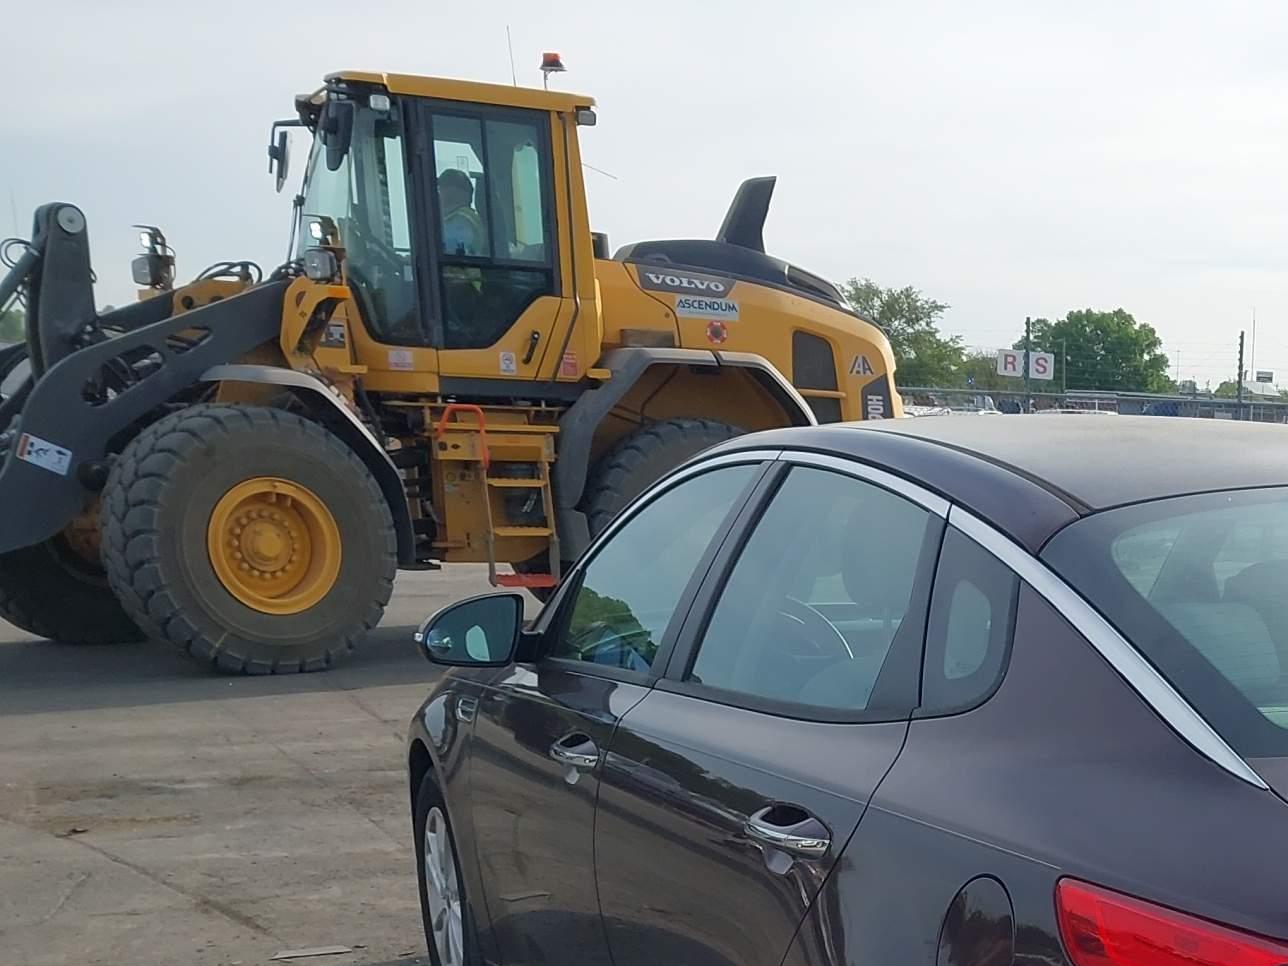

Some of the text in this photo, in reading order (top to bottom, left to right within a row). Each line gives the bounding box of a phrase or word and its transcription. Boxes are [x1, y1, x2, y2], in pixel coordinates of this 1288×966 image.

[645, 272, 725, 292] VOLVO
[676, 298, 738, 313] ASCENDUM
[1003, 353, 1018, 372] R
[1034, 356, 1049, 375] S
